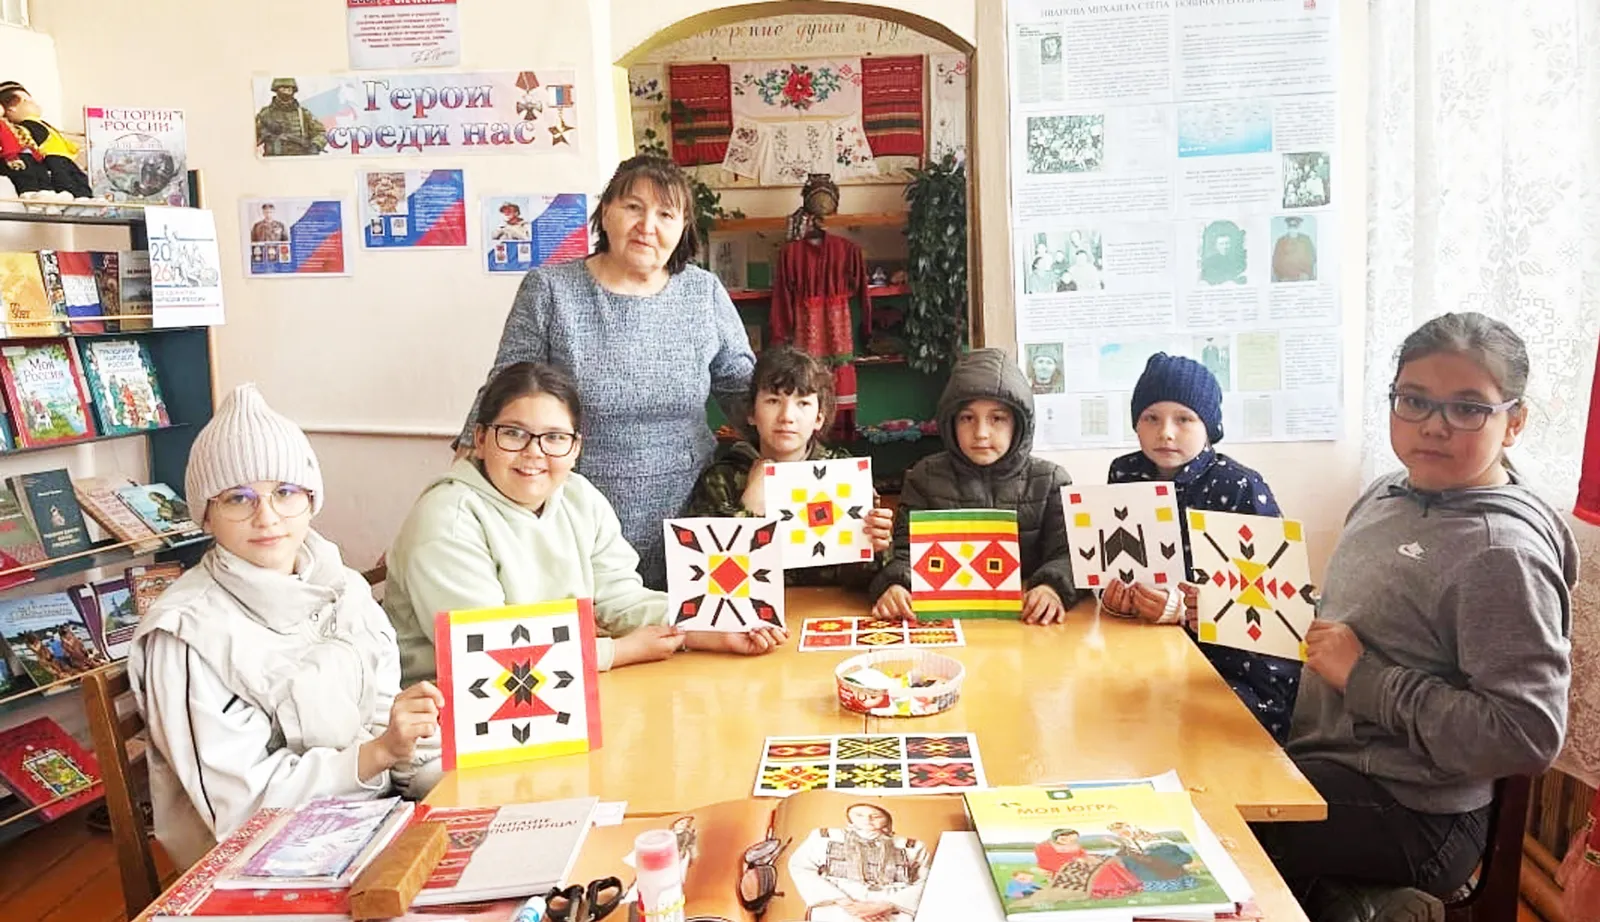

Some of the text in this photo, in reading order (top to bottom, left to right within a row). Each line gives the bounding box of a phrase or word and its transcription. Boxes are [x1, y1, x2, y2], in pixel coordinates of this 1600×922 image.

[796, 22, 846, 43] души
[877, 21, 908, 41] ру
[362, 80, 493, 119] Герои
[327, 121, 535, 154] среди нас
[151, 243, 172, 261] 20
[152, 263, 173, 282] 26
[1017, 803, 1119, 815] МОЯ ЮГРА
